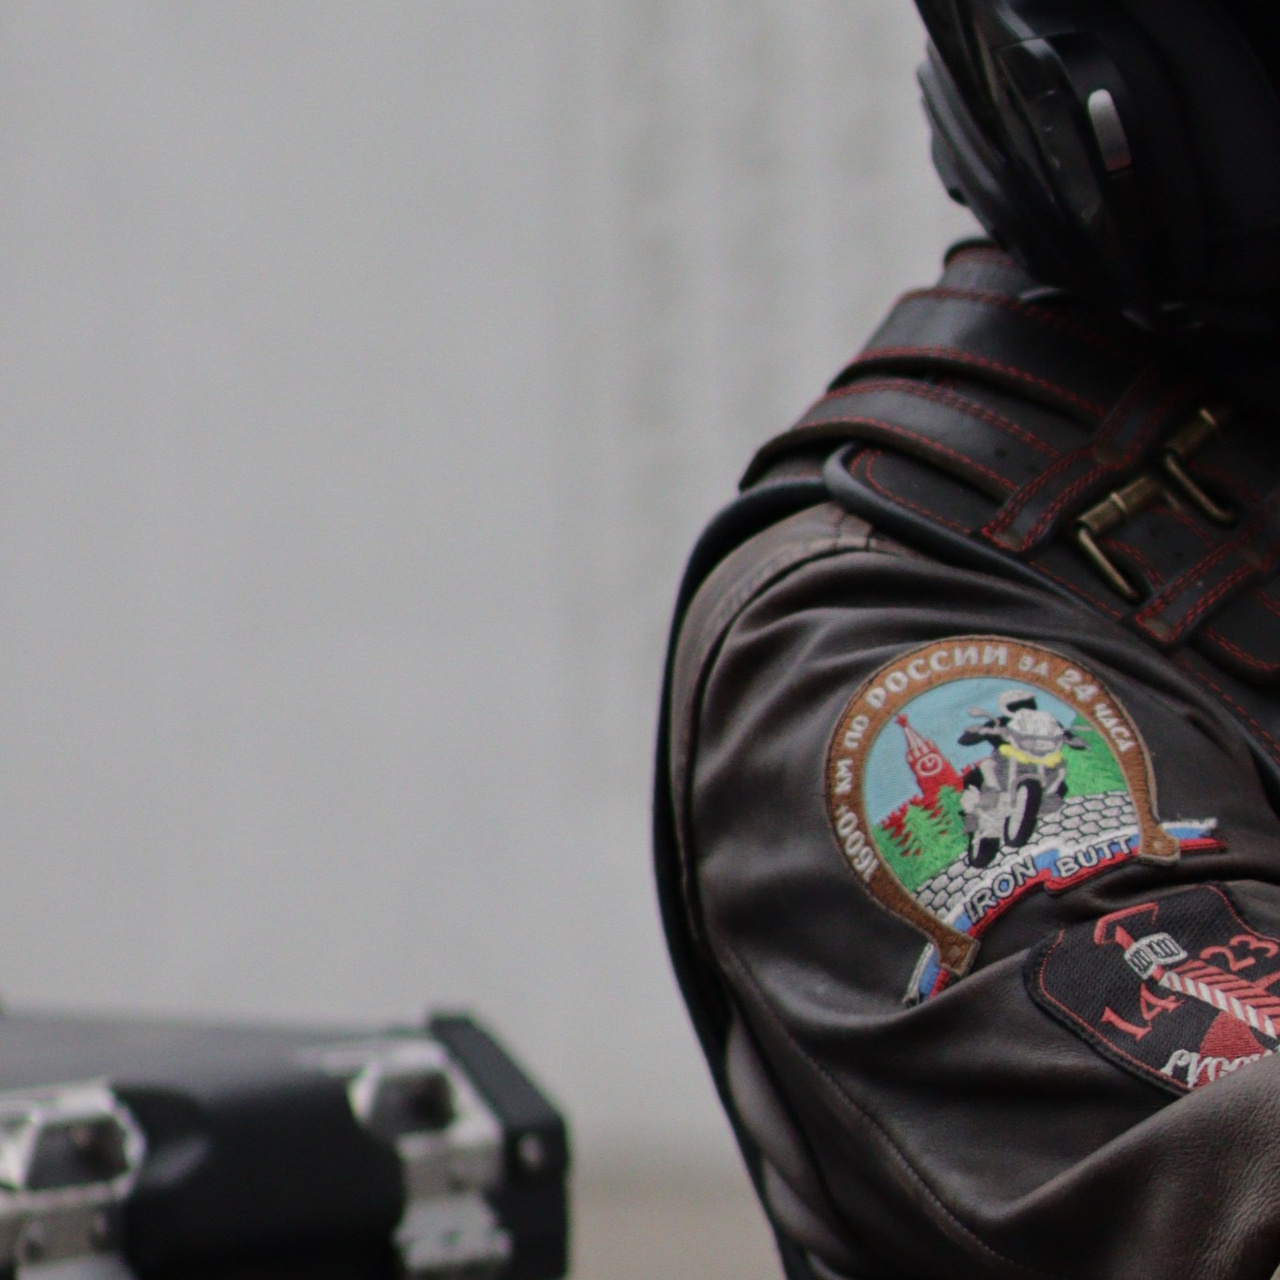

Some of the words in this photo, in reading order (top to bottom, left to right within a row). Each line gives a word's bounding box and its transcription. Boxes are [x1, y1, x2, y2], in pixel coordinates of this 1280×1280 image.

[843, 714, 870, 750] ПО
[865, 644, 1008, 709] РОССИИ
[1017, 654, 1049, 676] ЗА
[1056, 668, 1100, 702] 24
[1094, 702, 1137, 753] ЧАСА
[964, 853, 1038, 924] IRON
[1055, 834, 1132, 879] BUTT
[1200, 934, 1279, 973] 23
[1101, 982, 1185, 1042] 14
